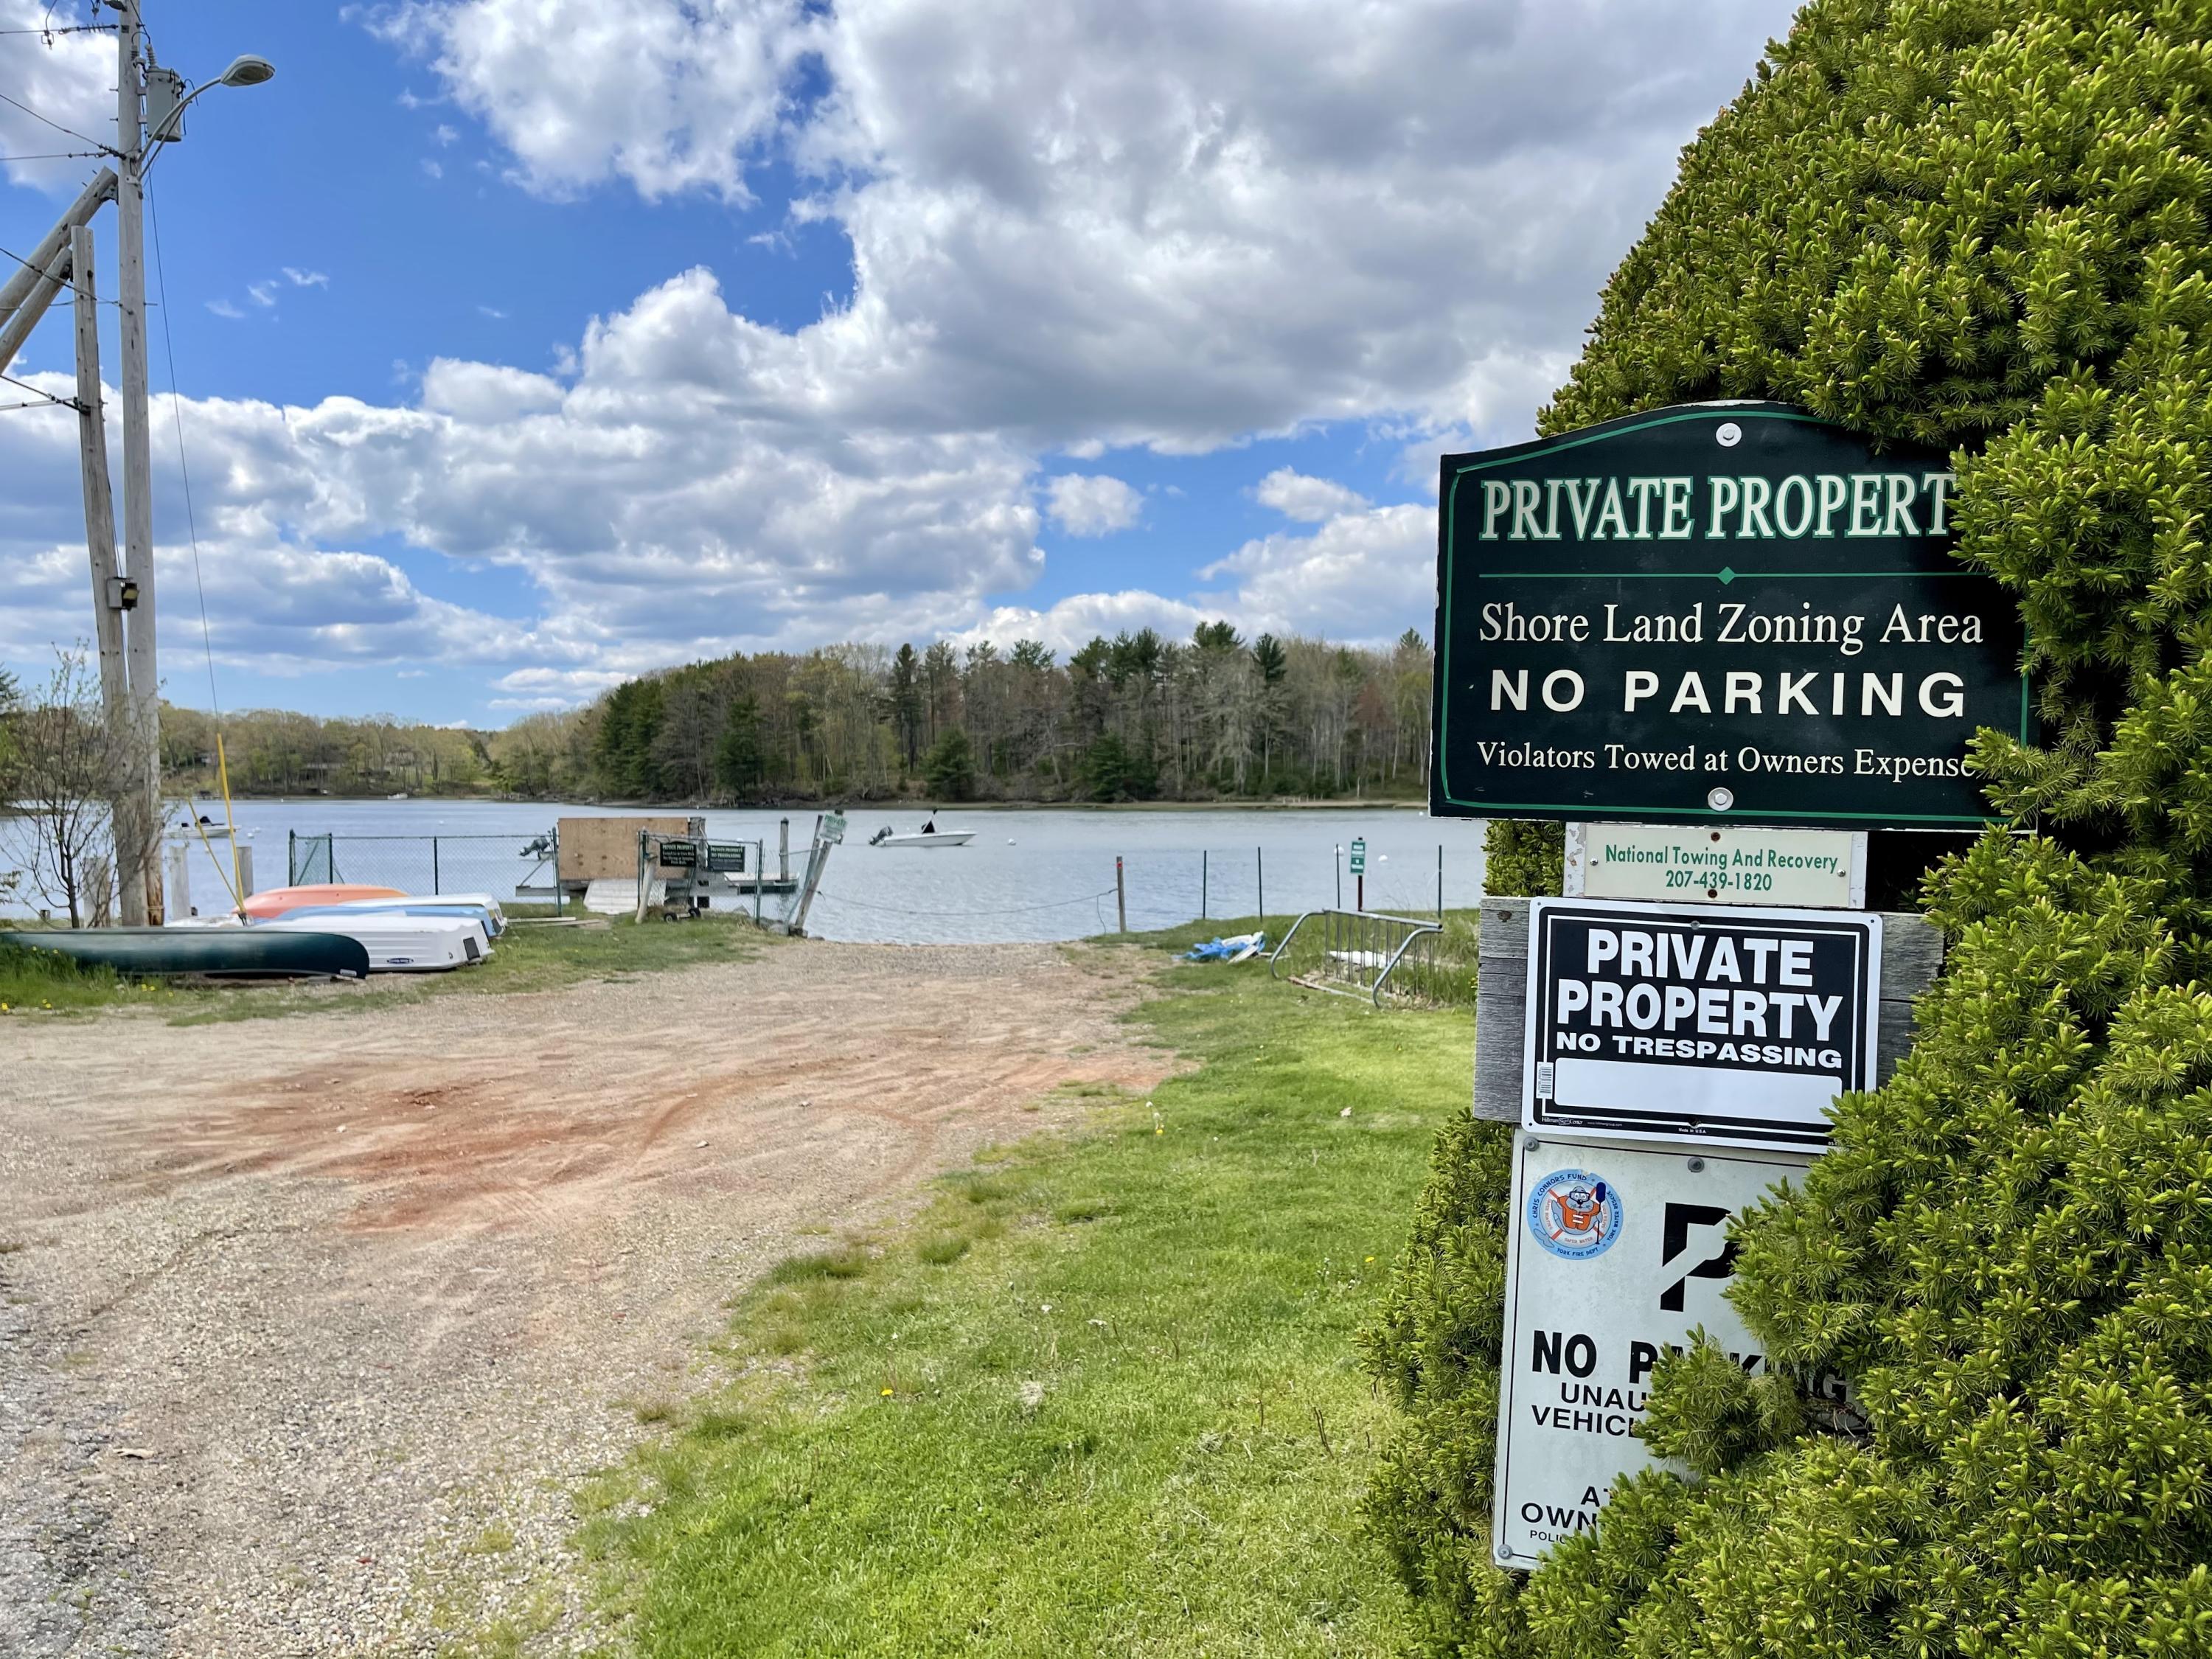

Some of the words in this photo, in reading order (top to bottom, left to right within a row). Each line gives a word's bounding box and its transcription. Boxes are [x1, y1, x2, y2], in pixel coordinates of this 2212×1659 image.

[1480, 476, 1694, 540] PRIVATE
[1705, 472, 1956, 538] PROPERT
[1480, 602, 1590, 642] Shore
[1603, 602, 1703, 642] Land
[1717, 602, 1865, 655] Zoning
[1879, 603, 1983, 644] Area
[1491, 669, 1585, 712] NO
[1624, 671, 1964, 717] PARKING
[1477, 742, 1595, 770] Violators
[1604, 745, 1695, 771] Towed
[1705, 751, 1728, 772] at
[1739, 747, 1843, 774] Owners
[1854, 748, 1976, 783] Expense
[1605, 844, 1669, 864] National
[1673, 846, 1728, 870] Towing
[1732, 848, 1763, 867] And
[1768, 849, 1838, 874] Recovery
[1666, 870, 1772, 891] 207-439-1820
[1588, 928, 1813, 986] PRIVATE
[1557, 979, 1843, 1041] PROPERTY
[1557, 1032, 1601, 1052] NO
[1613, 1036, 1842, 1068] TRESPASSING
[1531, 1198, 1540, 1218] CHRIS
[1537, 1175, 1565, 1196] CONNORS
[1568, 1173, 1587, 1181] FUND
[1557, 1248, 1571, 1256] YORK
[1586, 1247, 1599, 1256] DEPT
[1532, 1329, 1597, 1378] NO
[1531, 1405, 1641, 1439] VEHICL
